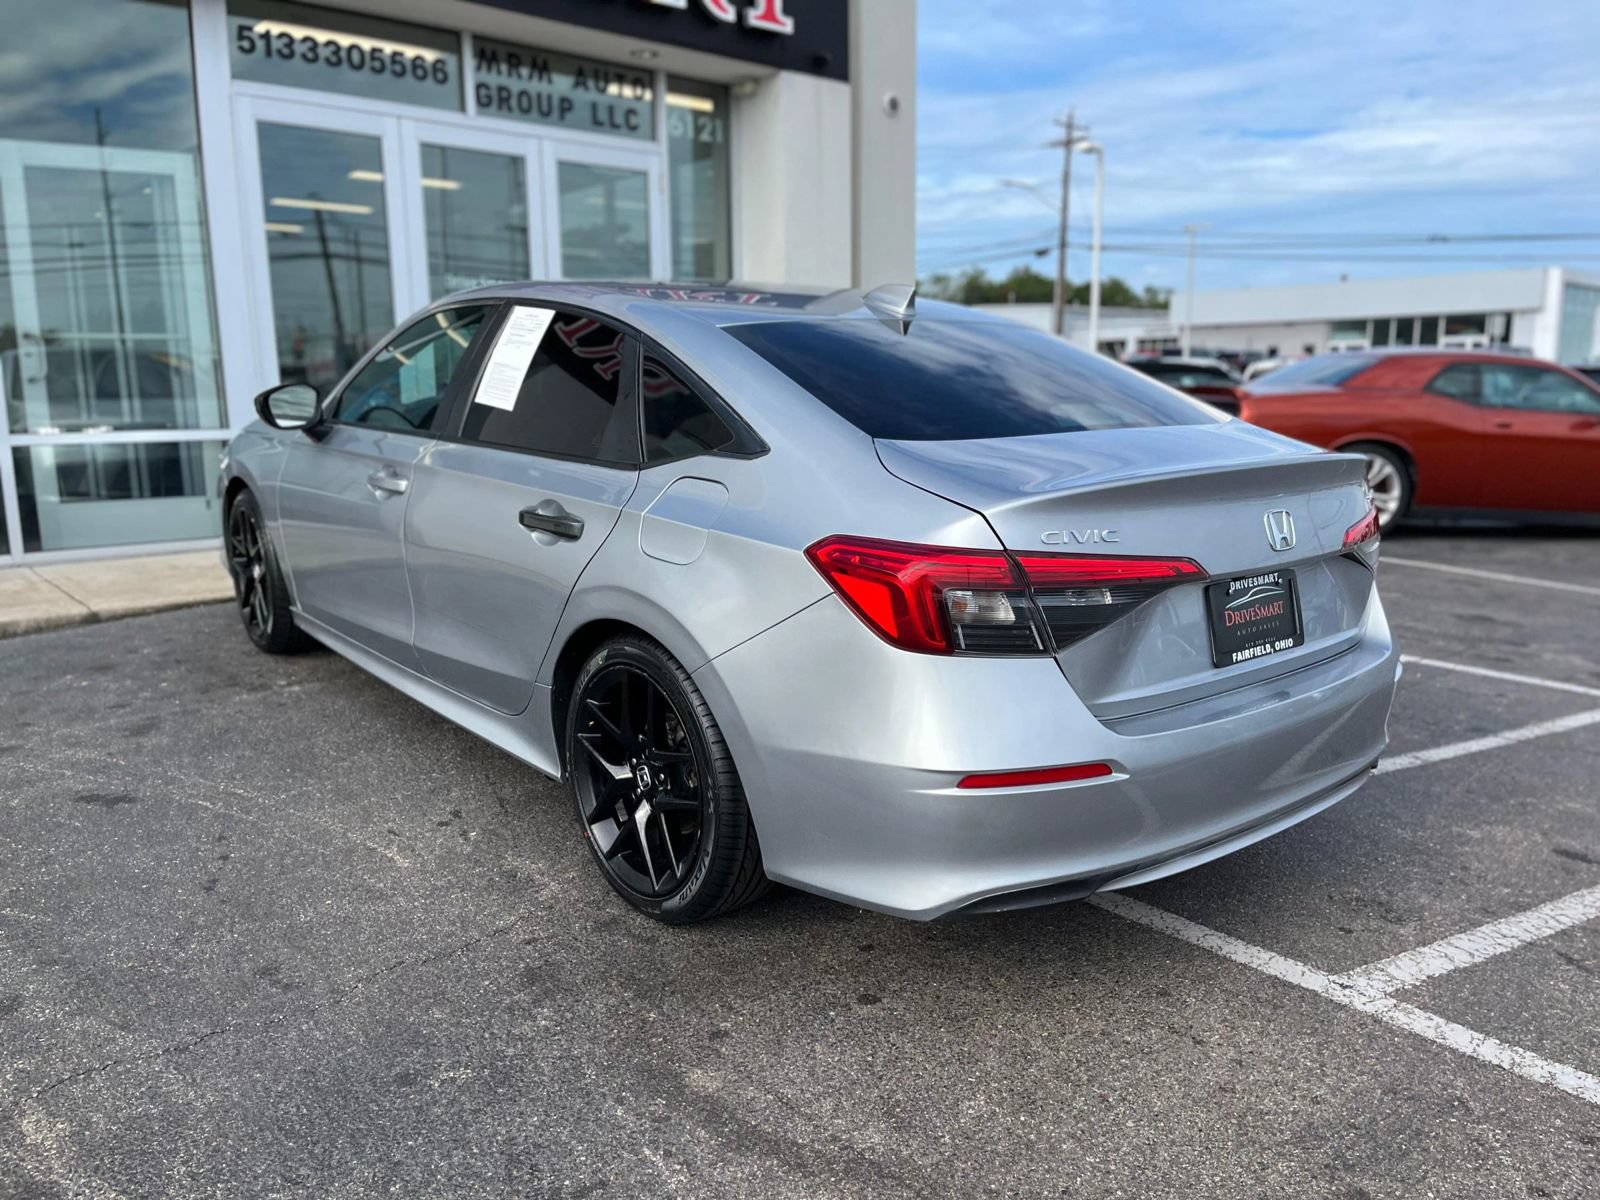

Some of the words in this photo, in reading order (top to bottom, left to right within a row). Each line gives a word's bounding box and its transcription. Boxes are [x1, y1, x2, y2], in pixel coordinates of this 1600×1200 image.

[237, 25, 449, 85] 5133305566
[475, 48, 553, 86] MRM
[572, 66, 645, 101] AUTO
[475, 83, 574, 121] GROUP
[591, 102, 640, 132] LLC
[1040, 529, 1120, 544] CIVIC
[1229, 573, 1279, 591] DRIVESMART
[1232, 643, 1274, 663] FAIRFIELD,
[1274, 638, 1294, 651] OHIO
